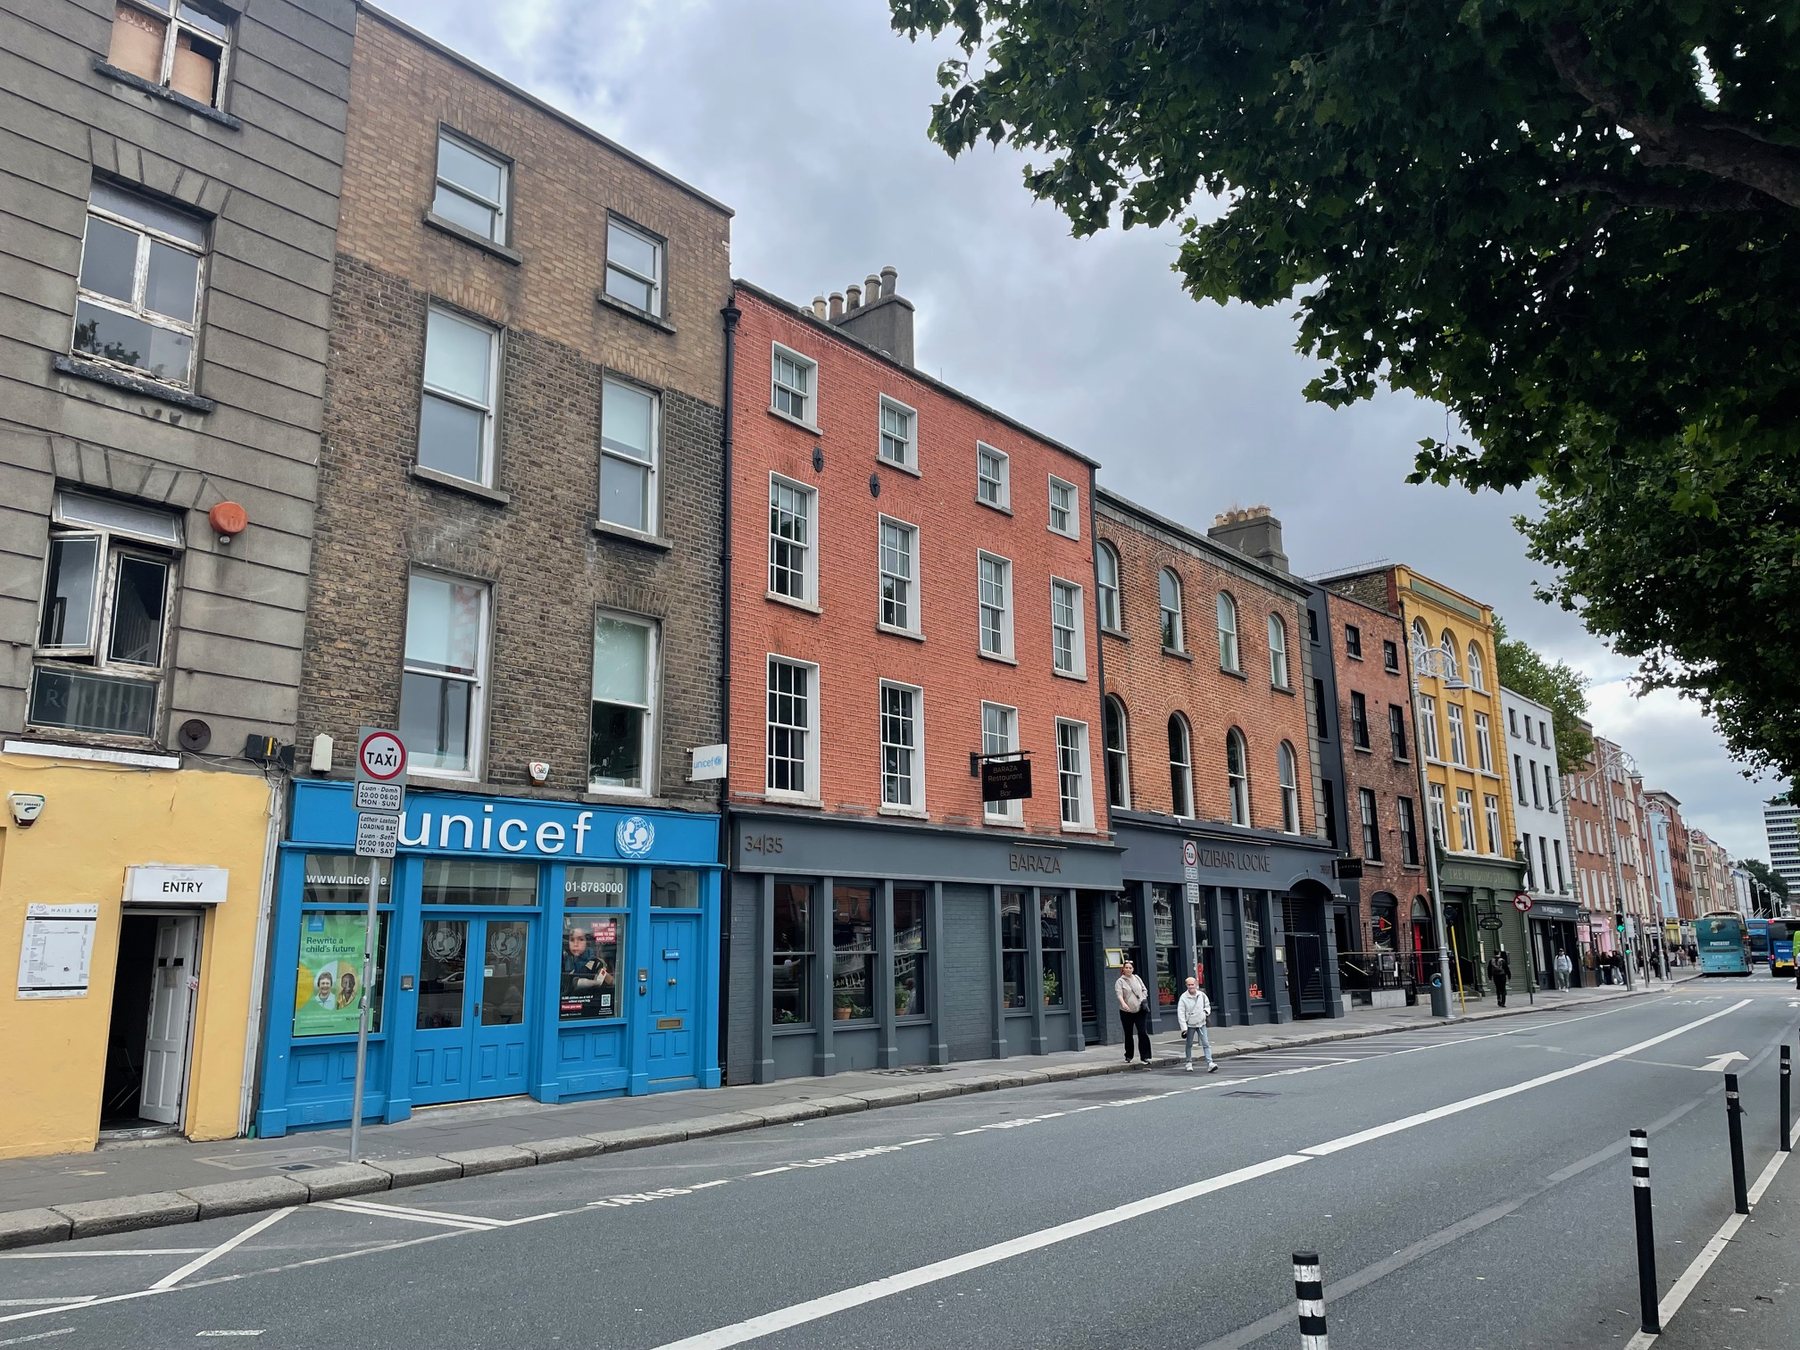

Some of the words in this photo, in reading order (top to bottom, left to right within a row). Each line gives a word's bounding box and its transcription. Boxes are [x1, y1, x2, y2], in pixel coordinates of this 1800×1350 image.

[366, 752, 397, 767] TAXI
[694, 756, 714, 768] unicef
[398, 804, 593, 854] unicef
[1009, 853, 1062, 874] BARAZA
[1180, 846, 1236, 870] NZIBAR
[1237, 852, 1271, 872] LOCKE
[162, 882, 203, 892] ENTRY
[565, 881, 624, 893] 01-8783000
[306, 936, 337, 944] Rewrite
